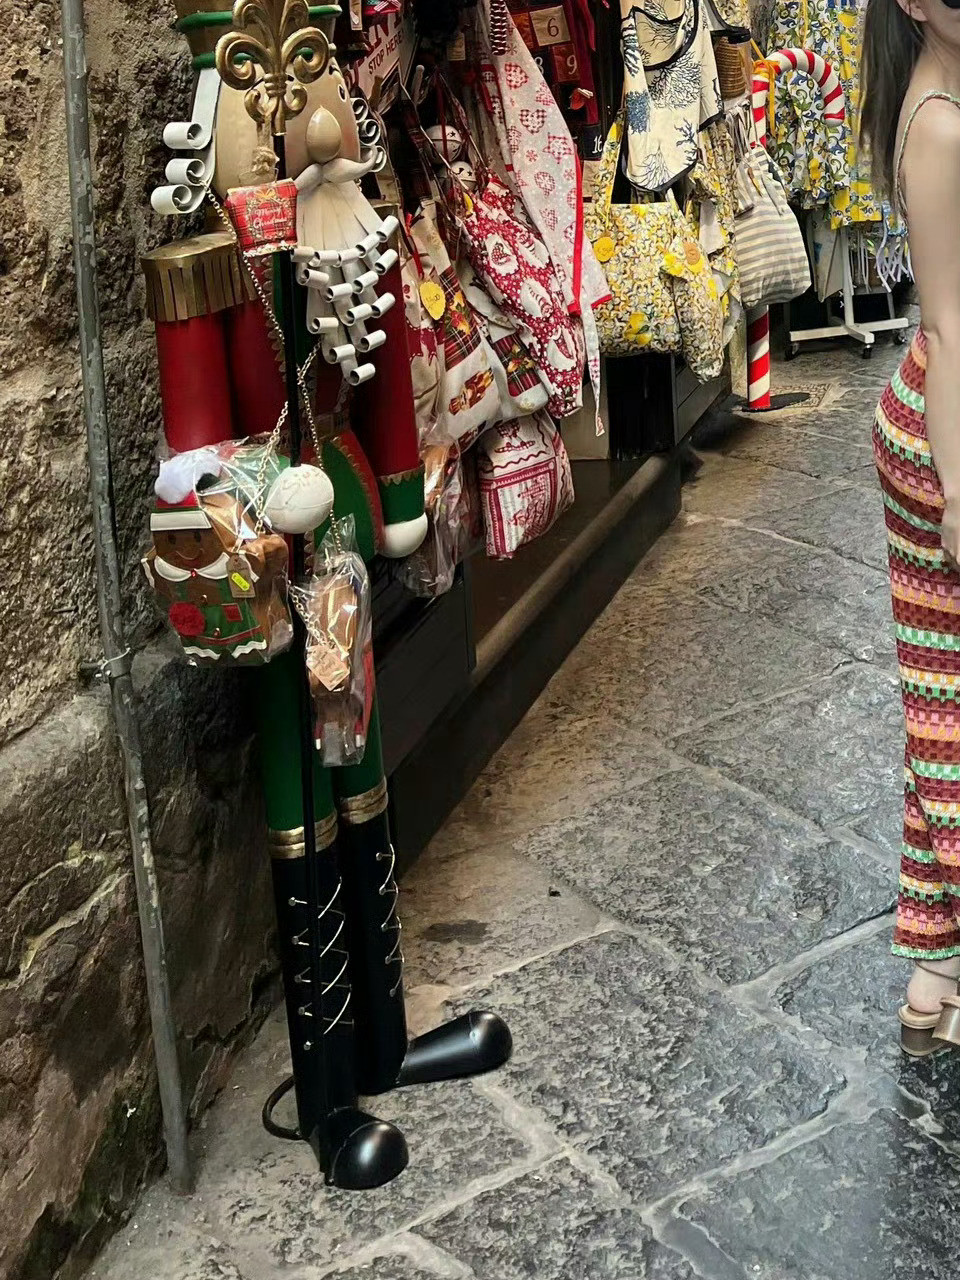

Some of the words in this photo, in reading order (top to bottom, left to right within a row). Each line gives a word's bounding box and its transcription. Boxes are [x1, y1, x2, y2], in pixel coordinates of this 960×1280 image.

[547, 17, 559, 38] 6
[368, 48, 385, 75] STOP
[566, 54, 578, 75] 9
